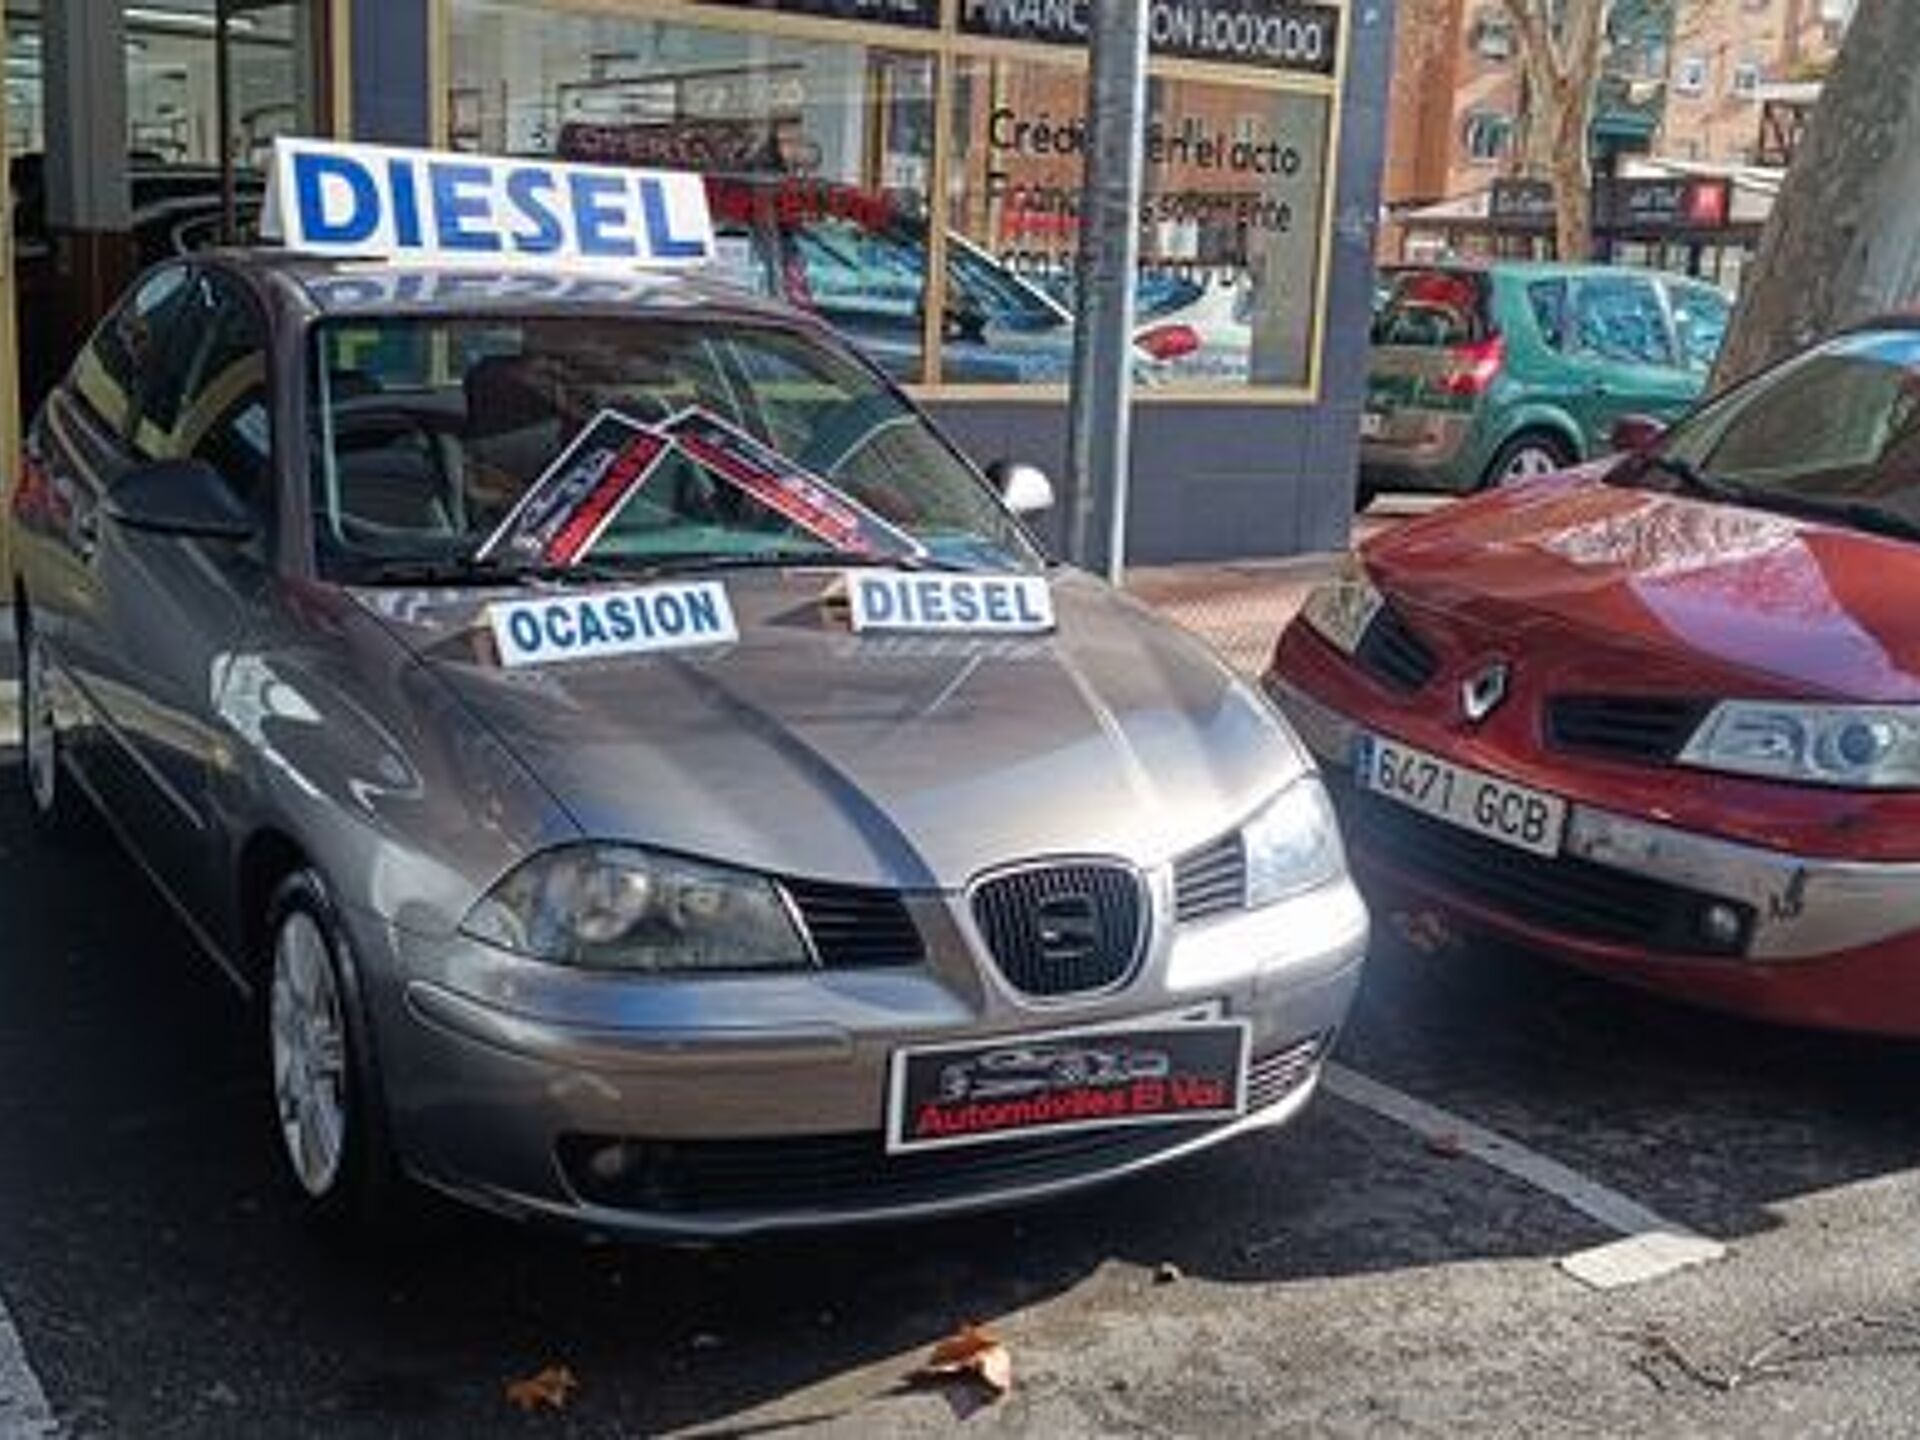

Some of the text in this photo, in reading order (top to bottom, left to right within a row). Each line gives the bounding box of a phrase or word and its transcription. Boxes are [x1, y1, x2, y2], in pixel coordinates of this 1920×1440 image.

[1230, 137, 1300, 175] acto
[292, 151, 707, 257] DIESEL
[510, 590, 720, 652] OCASION
[861, 580, 1043, 622] DIESEL
[1380, 748, 1548, 843] 6471 GCB
